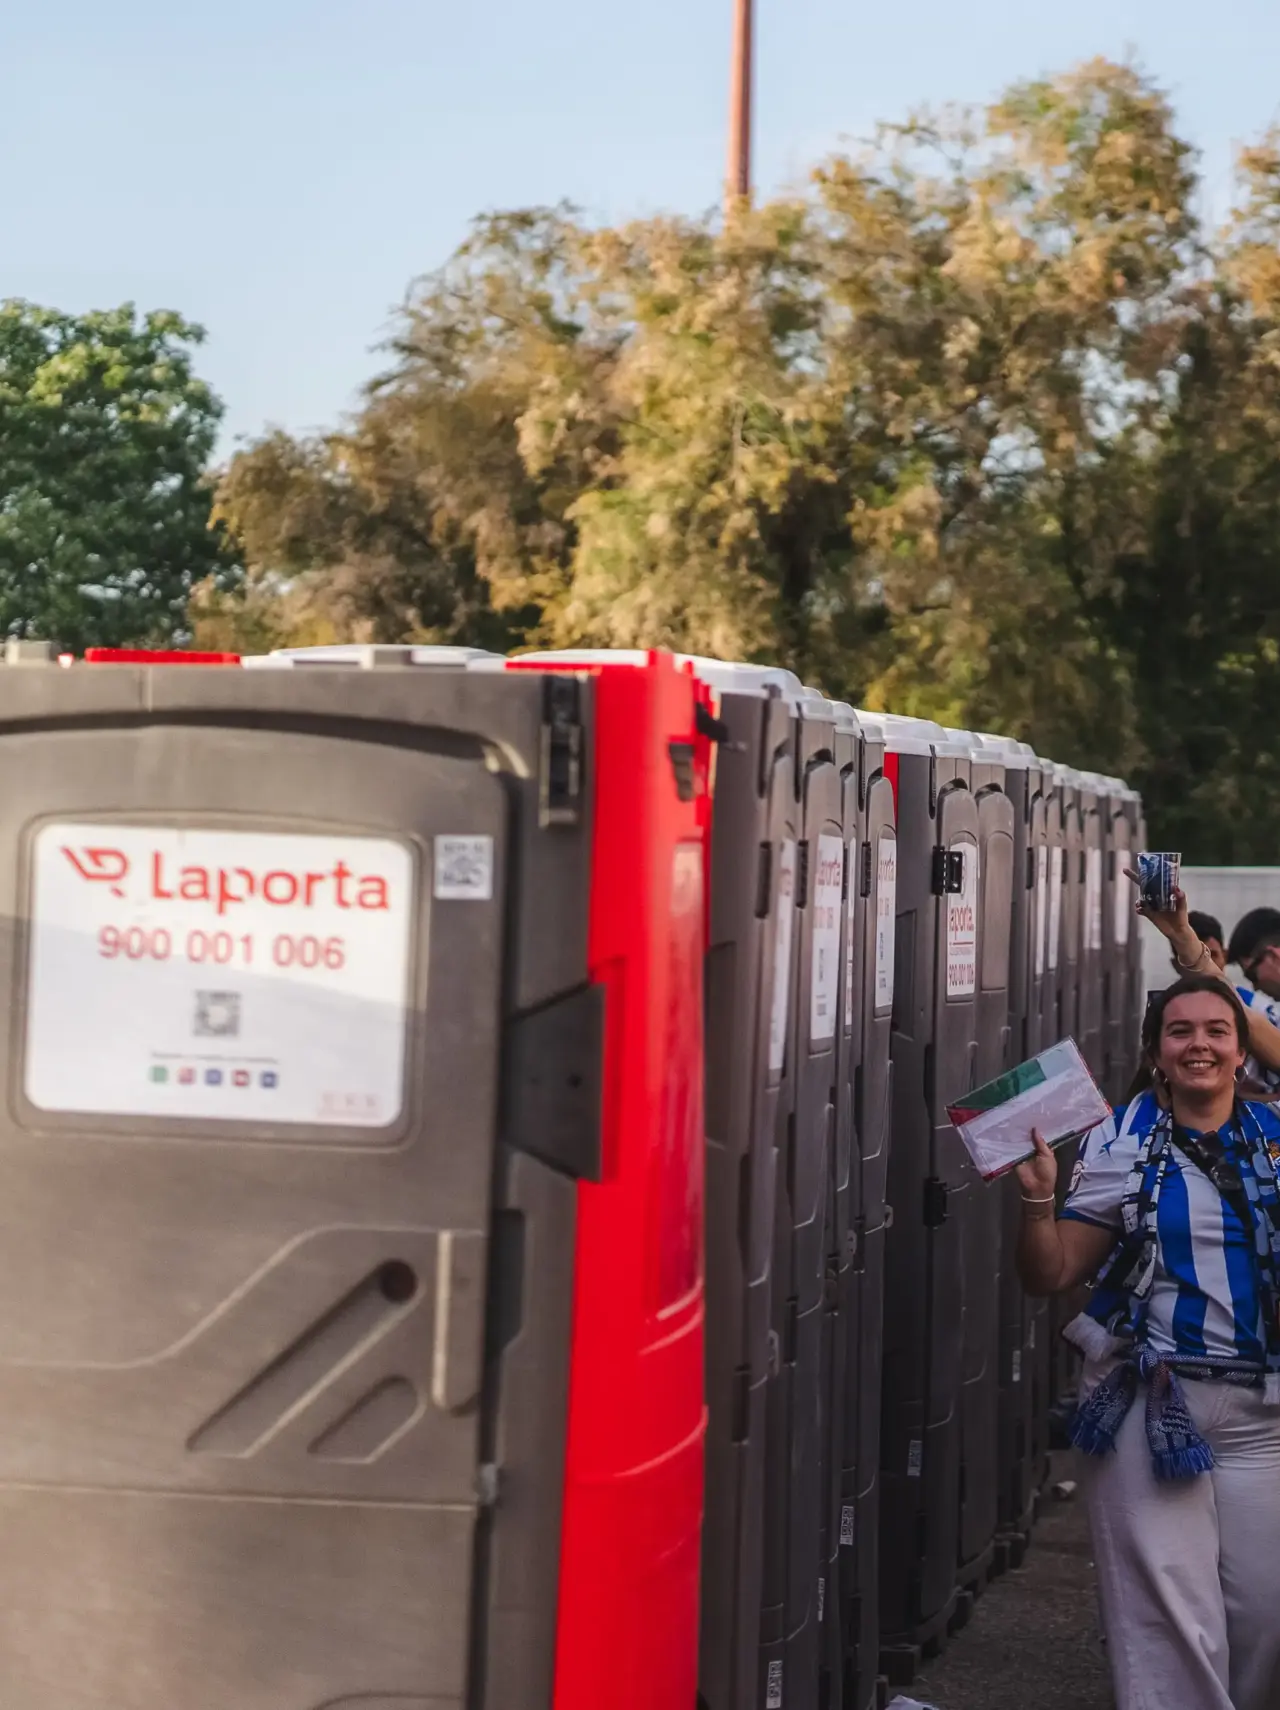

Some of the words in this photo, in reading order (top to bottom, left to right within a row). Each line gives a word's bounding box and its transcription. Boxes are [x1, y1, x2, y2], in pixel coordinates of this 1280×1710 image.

[152, 851, 391, 914] Laporta
[99, 925, 171, 960] 900
[187, 930, 254, 964] 001
[272, 935, 346, 969] 006
